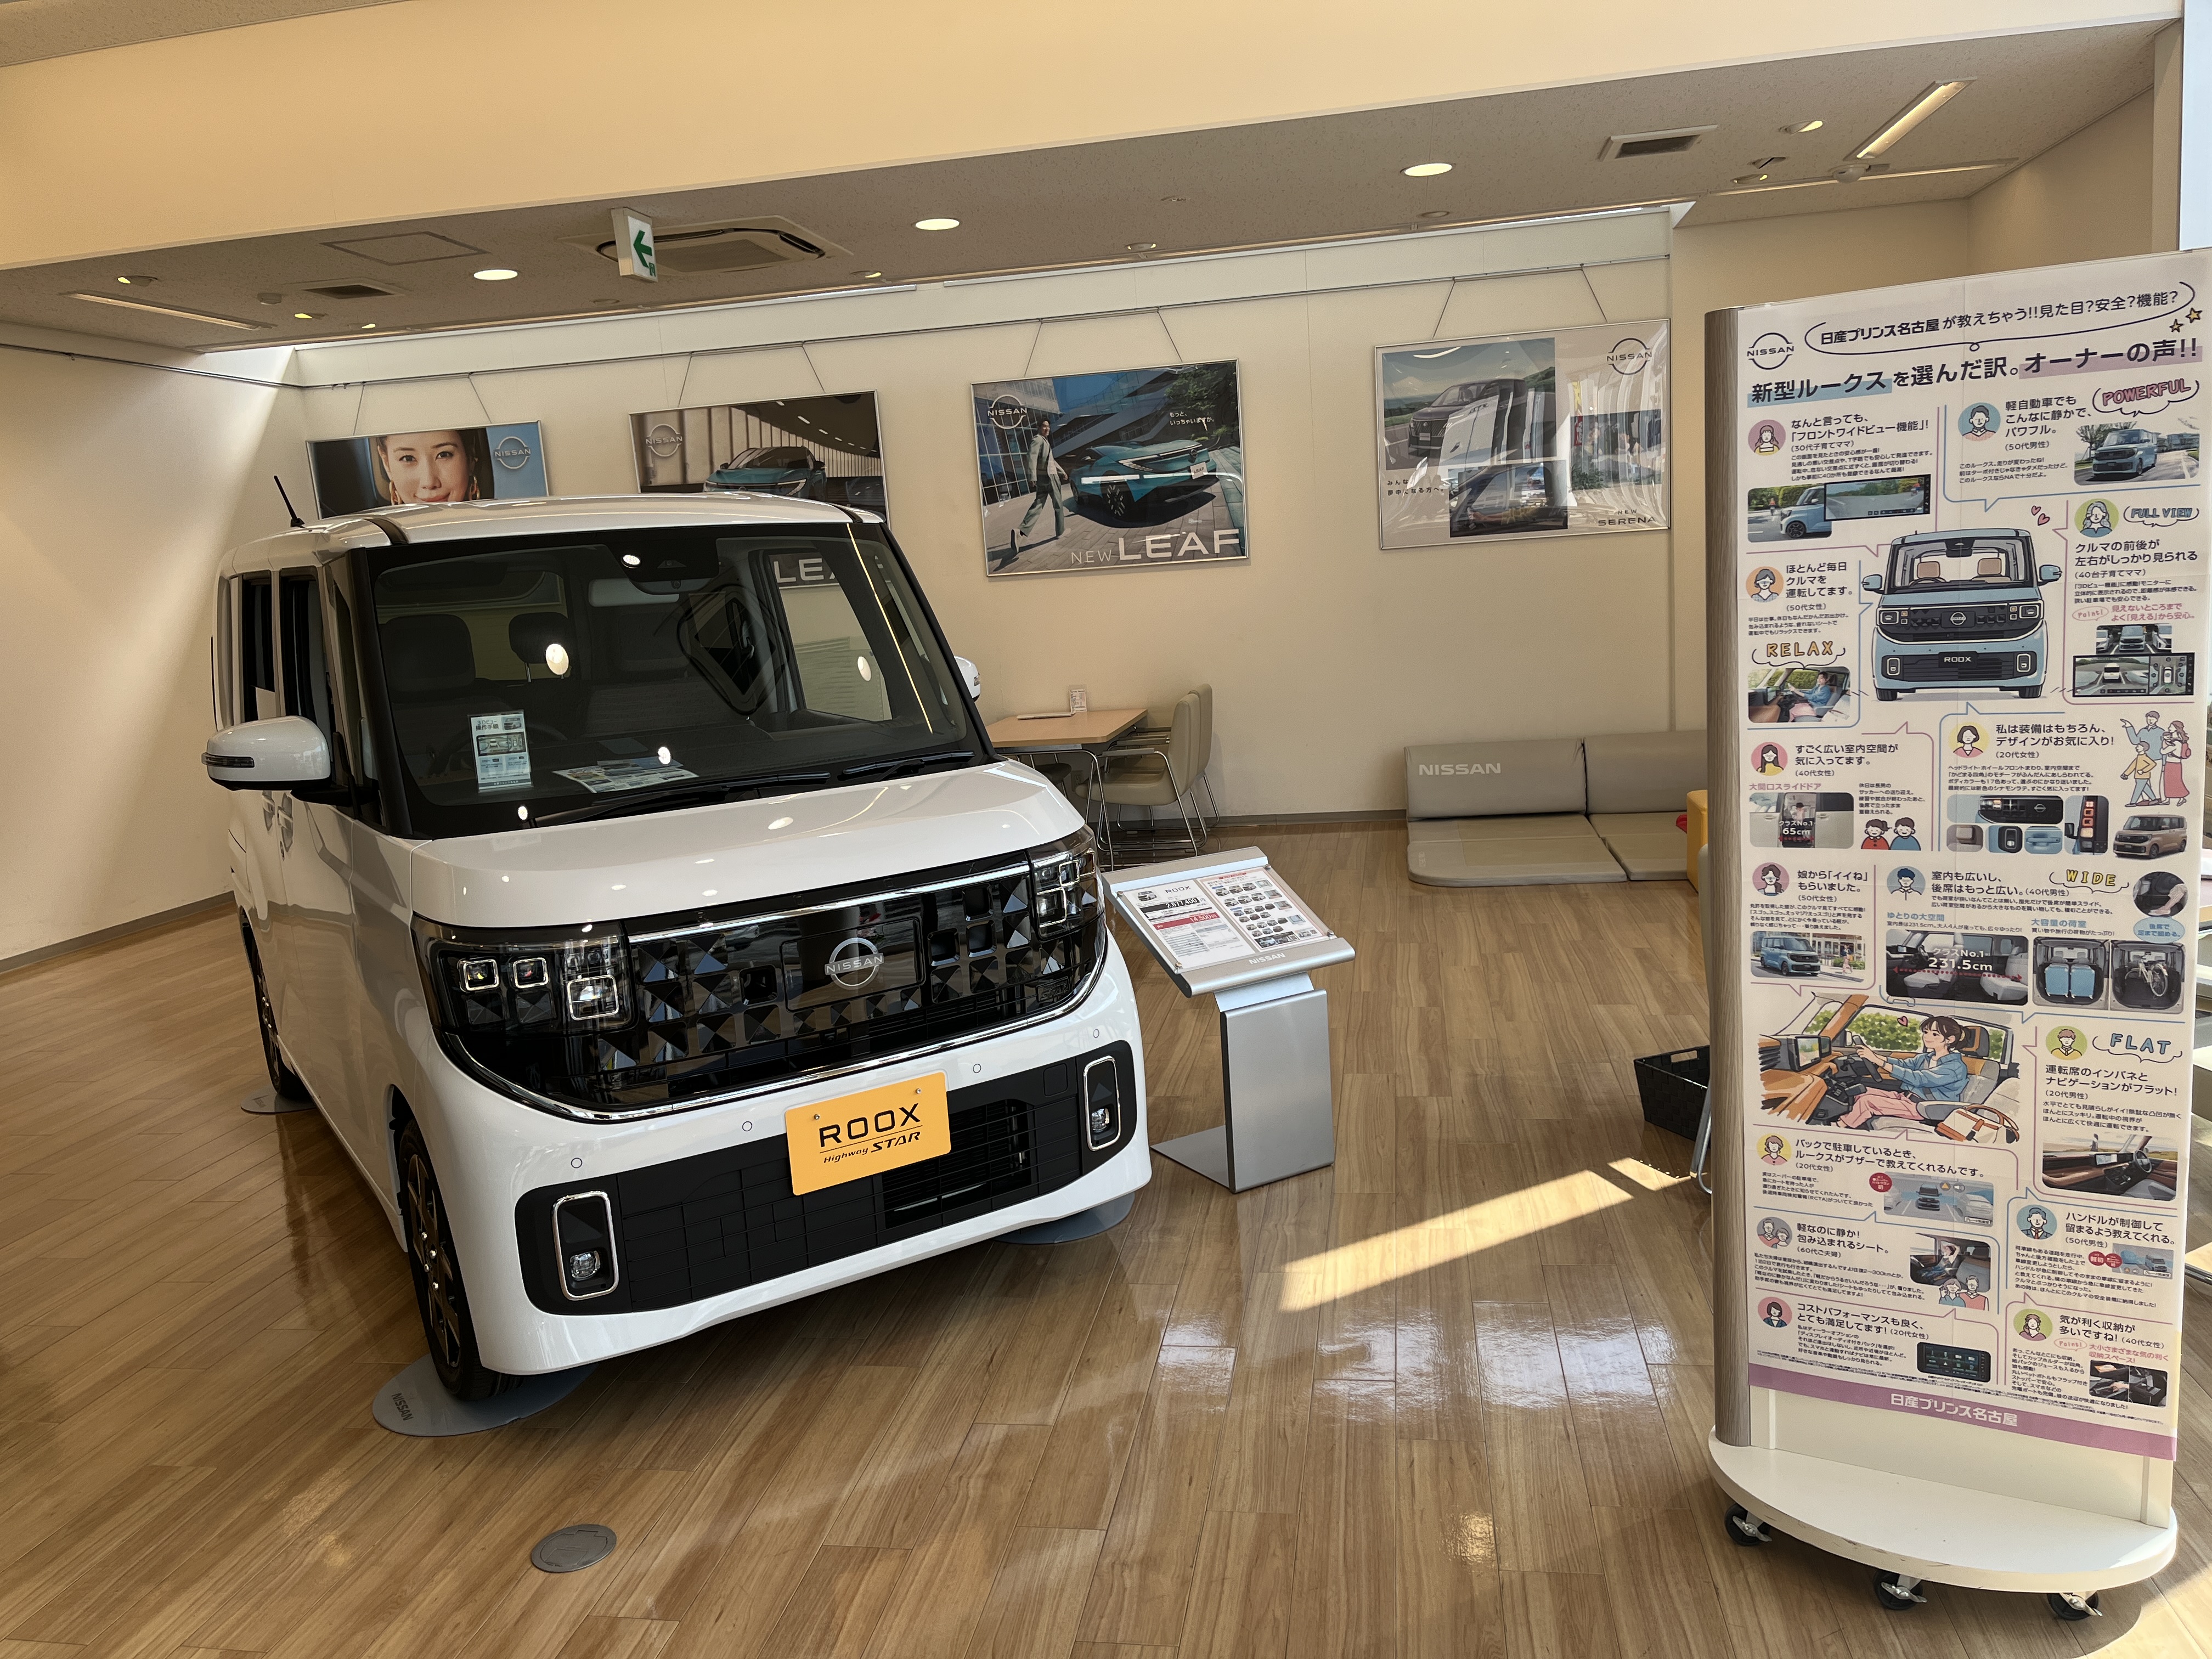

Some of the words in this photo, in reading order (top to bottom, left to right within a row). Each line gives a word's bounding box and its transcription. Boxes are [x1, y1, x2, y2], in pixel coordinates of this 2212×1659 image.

[1606, 351, 1652, 362] NISSAN
[1747, 345, 1795, 357] NISSAN
[2102, 378, 2192, 407] POWERFUL
[2005, 396, 2077, 411] 軽自動車でも
[988, 407, 1028, 416] NISSAN
[2006, 408, 2092, 424] こんなに静かで、
[1791, 414, 1869, 428] なんと言っても、
[2005, 424, 2057, 438] パワフル。
[646, 436, 683, 444] NISSAN
[1791, 440, 1854, 453] (30代子育てママ)
[2005, 440, 2050, 452] (50代男性)
[494, 448, 531, 456] NISSAN
[2131, 507, 2160, 518] FULL
[2162, 507, 2193, 518] VIEW
[1598, 516, 1656, 526] SERENA
[1070, 549, 1113, 564] NEW
[1118, 529, 1240, 561] LEAF
[2075, 539, 2160, 554] クルマの前後が
[2075, 550, 2198, 567] 左右がしっかり見られる
[1786, 561, 1847, 574] ほとんど毎日
[1786, 575, 1827, 586] クルマを
[1786, 586, 1853, 599] 運転してます。
[1786, 603, 1826, 612] (50代女性)
[2112, 603, 2182, 612] 見えないところまで
[1766, 640, 1834, 657] RELAX
[1996, 723, 2106, 734] 私は装備はもちろん、
[1996, 736, 2114, 746] デザインがお気に入り!
[1795, 743, 1899, 754] すごく広い室内空間が
[1996, 750, 2040, 759] (20代女性)
[1795, 756, 1871, 766] 気に入ってます。
[1419, 763, 1501, 776] NISSAN
[1782, 827, 1811, 836] 65cm
[1797, 870, 1869, 882] 娘から「イイね」
[1931, 871, 2002, 882] 室内も広いし、
[2066, 870, 2117, 887] WIDE
[1165, 885, 1191, 894] ROOX
[1798, 882, 1861, 892] もらいました。
[1887, 912, 1945, 922] ゆとりの大空間
[2031, 918, 2087, 928] 大容量の荷室
[826, 955, 883, 973] NISSAN
[1248, 952, 1286, 965] NISSAN
[1928, 957, 1993, 971] 231.5cm
[2110, 1033, 2171, 1054] FLAT
[2045, 1064, 2148, 1081] 運転席のインパネと
[2045, 1076, 2177, 1096] ナビゲーションがフラット!
[2045, 1090, 2089, 1100] (20代男性)
[819, 1103, 921, 1148] ROOX
[823, 1147, 868, 1164] Highway
[870, 1131, 921, 1153] STAR
[1796, 1139, 1917, 1159] バックで駐車しているとき、
[1796, 1163, 1833, 1172] (20代女性)
[2066, 1212, 2163, 1232] ハンドルが制御して
[1797, 1223, 1860, 1239] 軽なのに静か!
[2066, 1223, 2175, 1245] 留まるよう教えてくれる。
[1797, 1234, 1889, 1255] 包み込まれるシート。
[2065, 1237, 2108, 1248] (50代男性)
[1797, 1302, 1924, 1330] コストパフォーマンスも良く、
[2059, 1315, 2136, 1333] 気が利く収納が
[2059, 1326, 2118, 1342] 多いですね!
[2089, 1344, 2169, 1362] 大小さまざまな気の利く
[391, 1392, 414, 1421] NISSAN
[1890, 1392, 2018, 1427] 日産プリンス名古屋
